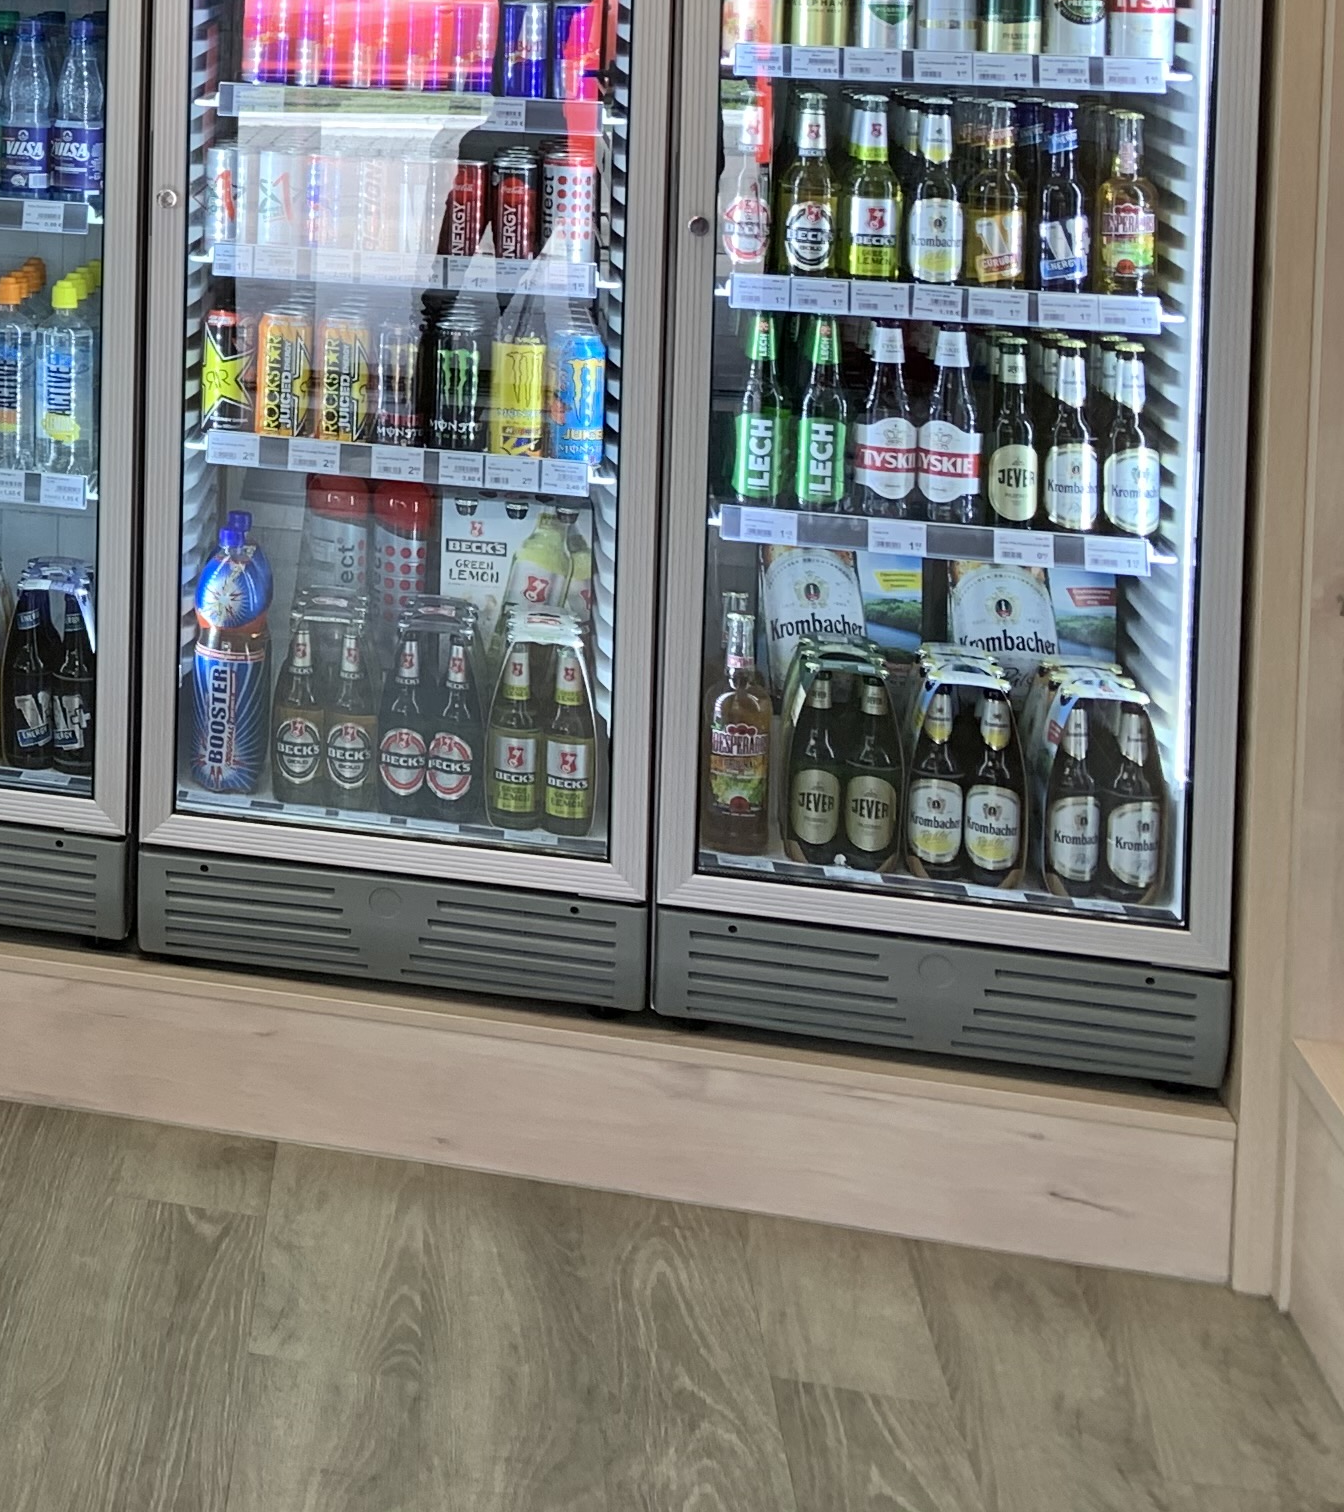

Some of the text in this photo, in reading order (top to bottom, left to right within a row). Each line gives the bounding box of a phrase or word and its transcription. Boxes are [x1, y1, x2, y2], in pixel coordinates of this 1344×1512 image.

[6, 140, 45, 160] VILSA
[50, 365, 73, 417] ACTIVE
[281, 371, 292, 428] JUICED
[340, 372, 350, 430] JUICED
[748, 418, 774, 492] LECH
[809, 423, 834, 496] LECH
[447, 540, 506, 558] BECK'S
[456, 559, 494, 571] GREEN
[448, 568, 499, 585] LEMON
[771, 615, 864, 642] Krombacher
[208, 665, 229, 764] BOOSTER
[19, 726, 49, 743] ENERGY
[495, 770, 535, 784] BECK'S
[548, 777, 588, 789] BECK'S
[798, 793, 835, 812] JEVER
[852, 799, 888, 818] JEVER
